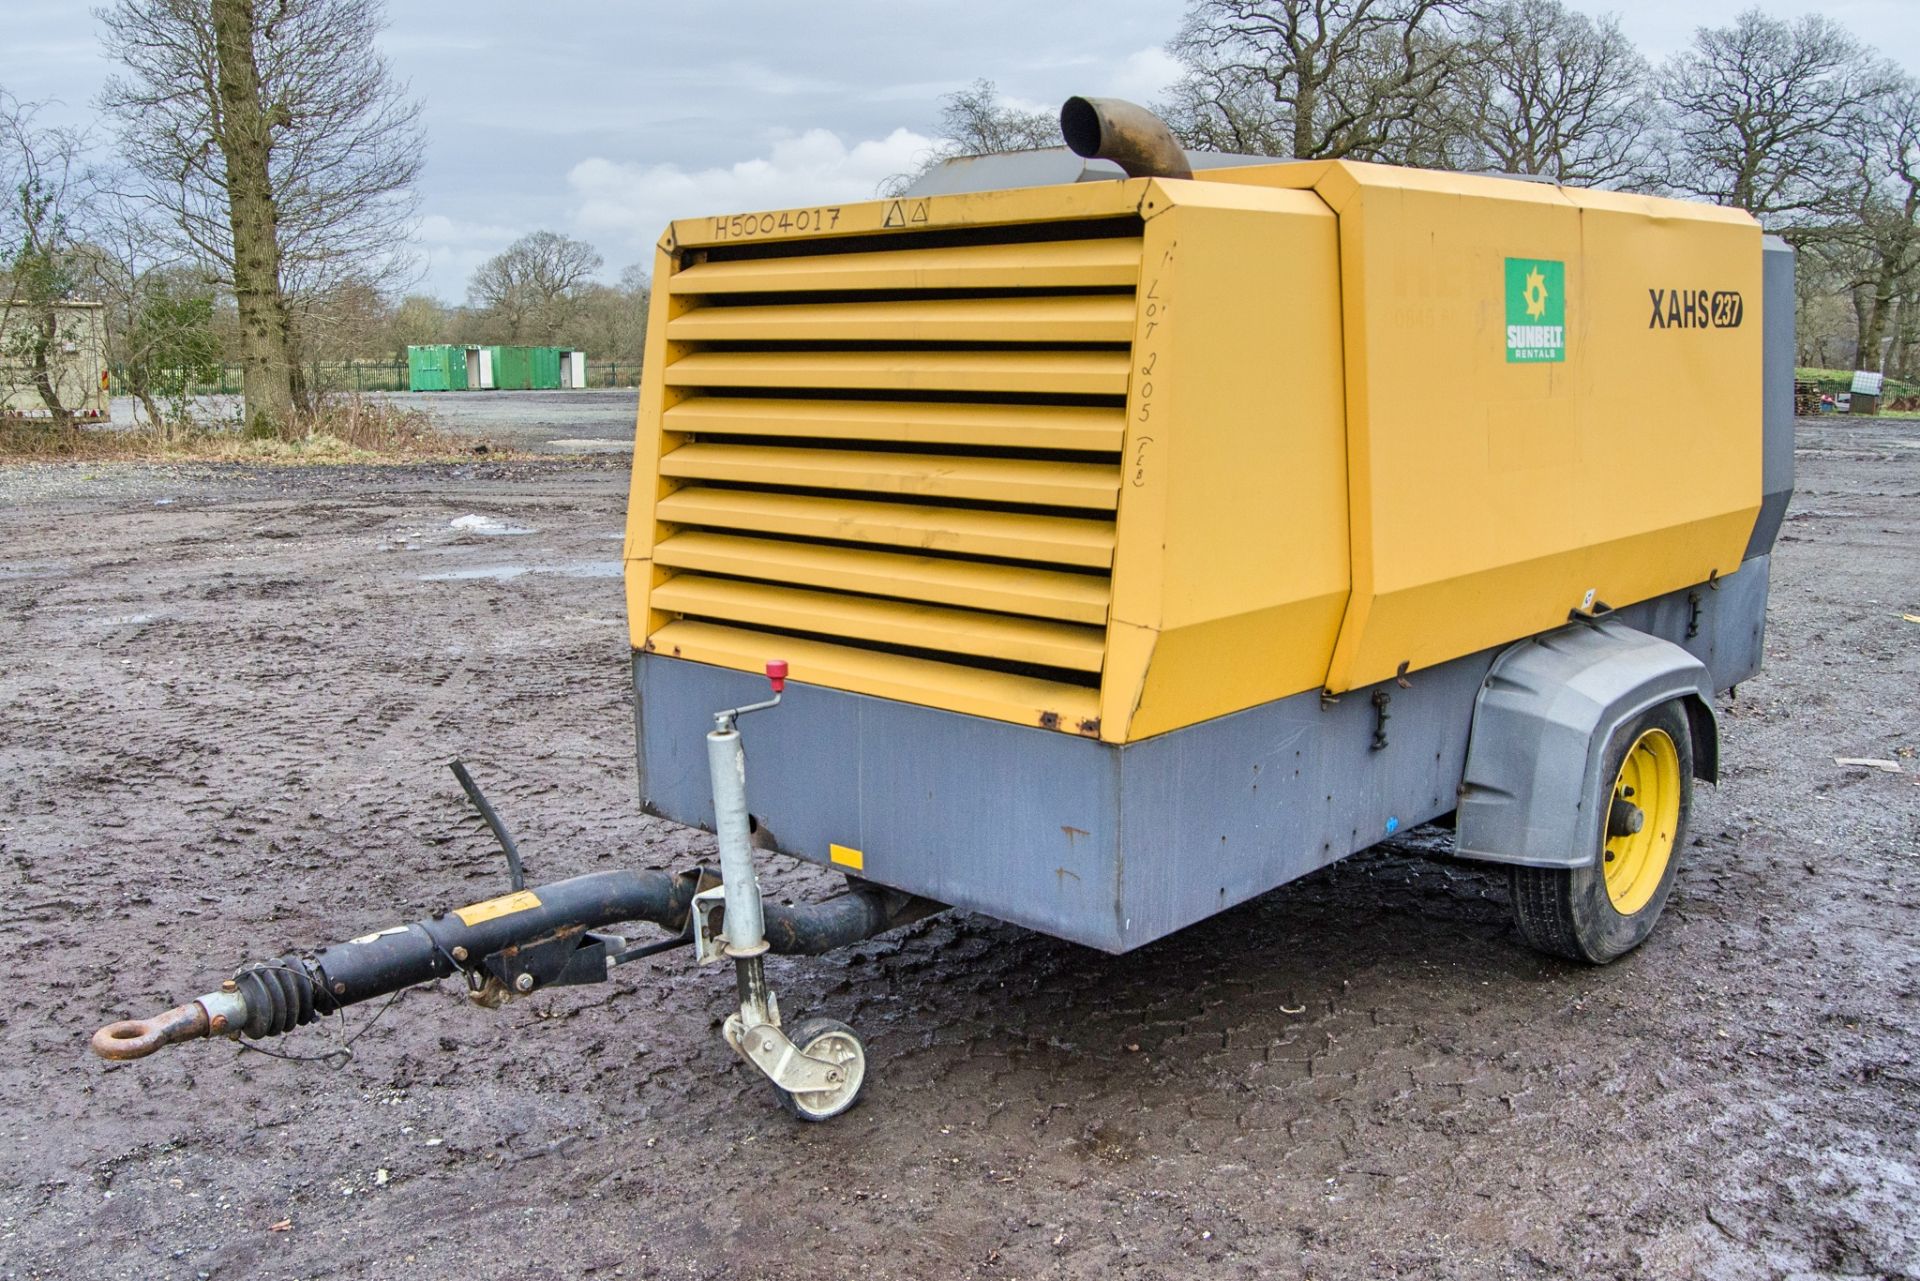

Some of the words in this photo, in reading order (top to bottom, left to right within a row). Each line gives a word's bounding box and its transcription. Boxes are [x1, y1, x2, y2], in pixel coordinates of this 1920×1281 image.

[715, 207, 841, 240] H5004017
[1146, 279, 1160, 339] LOT
[1648, 288, 1709, 329] XAHS
[1713, 292, 1741, 327] 237
[1507, 325, 1563, 348] SUNBELT
[1515, 348, 1556, 359] RENTALS
[1138, 352, 1157, 423] 205
